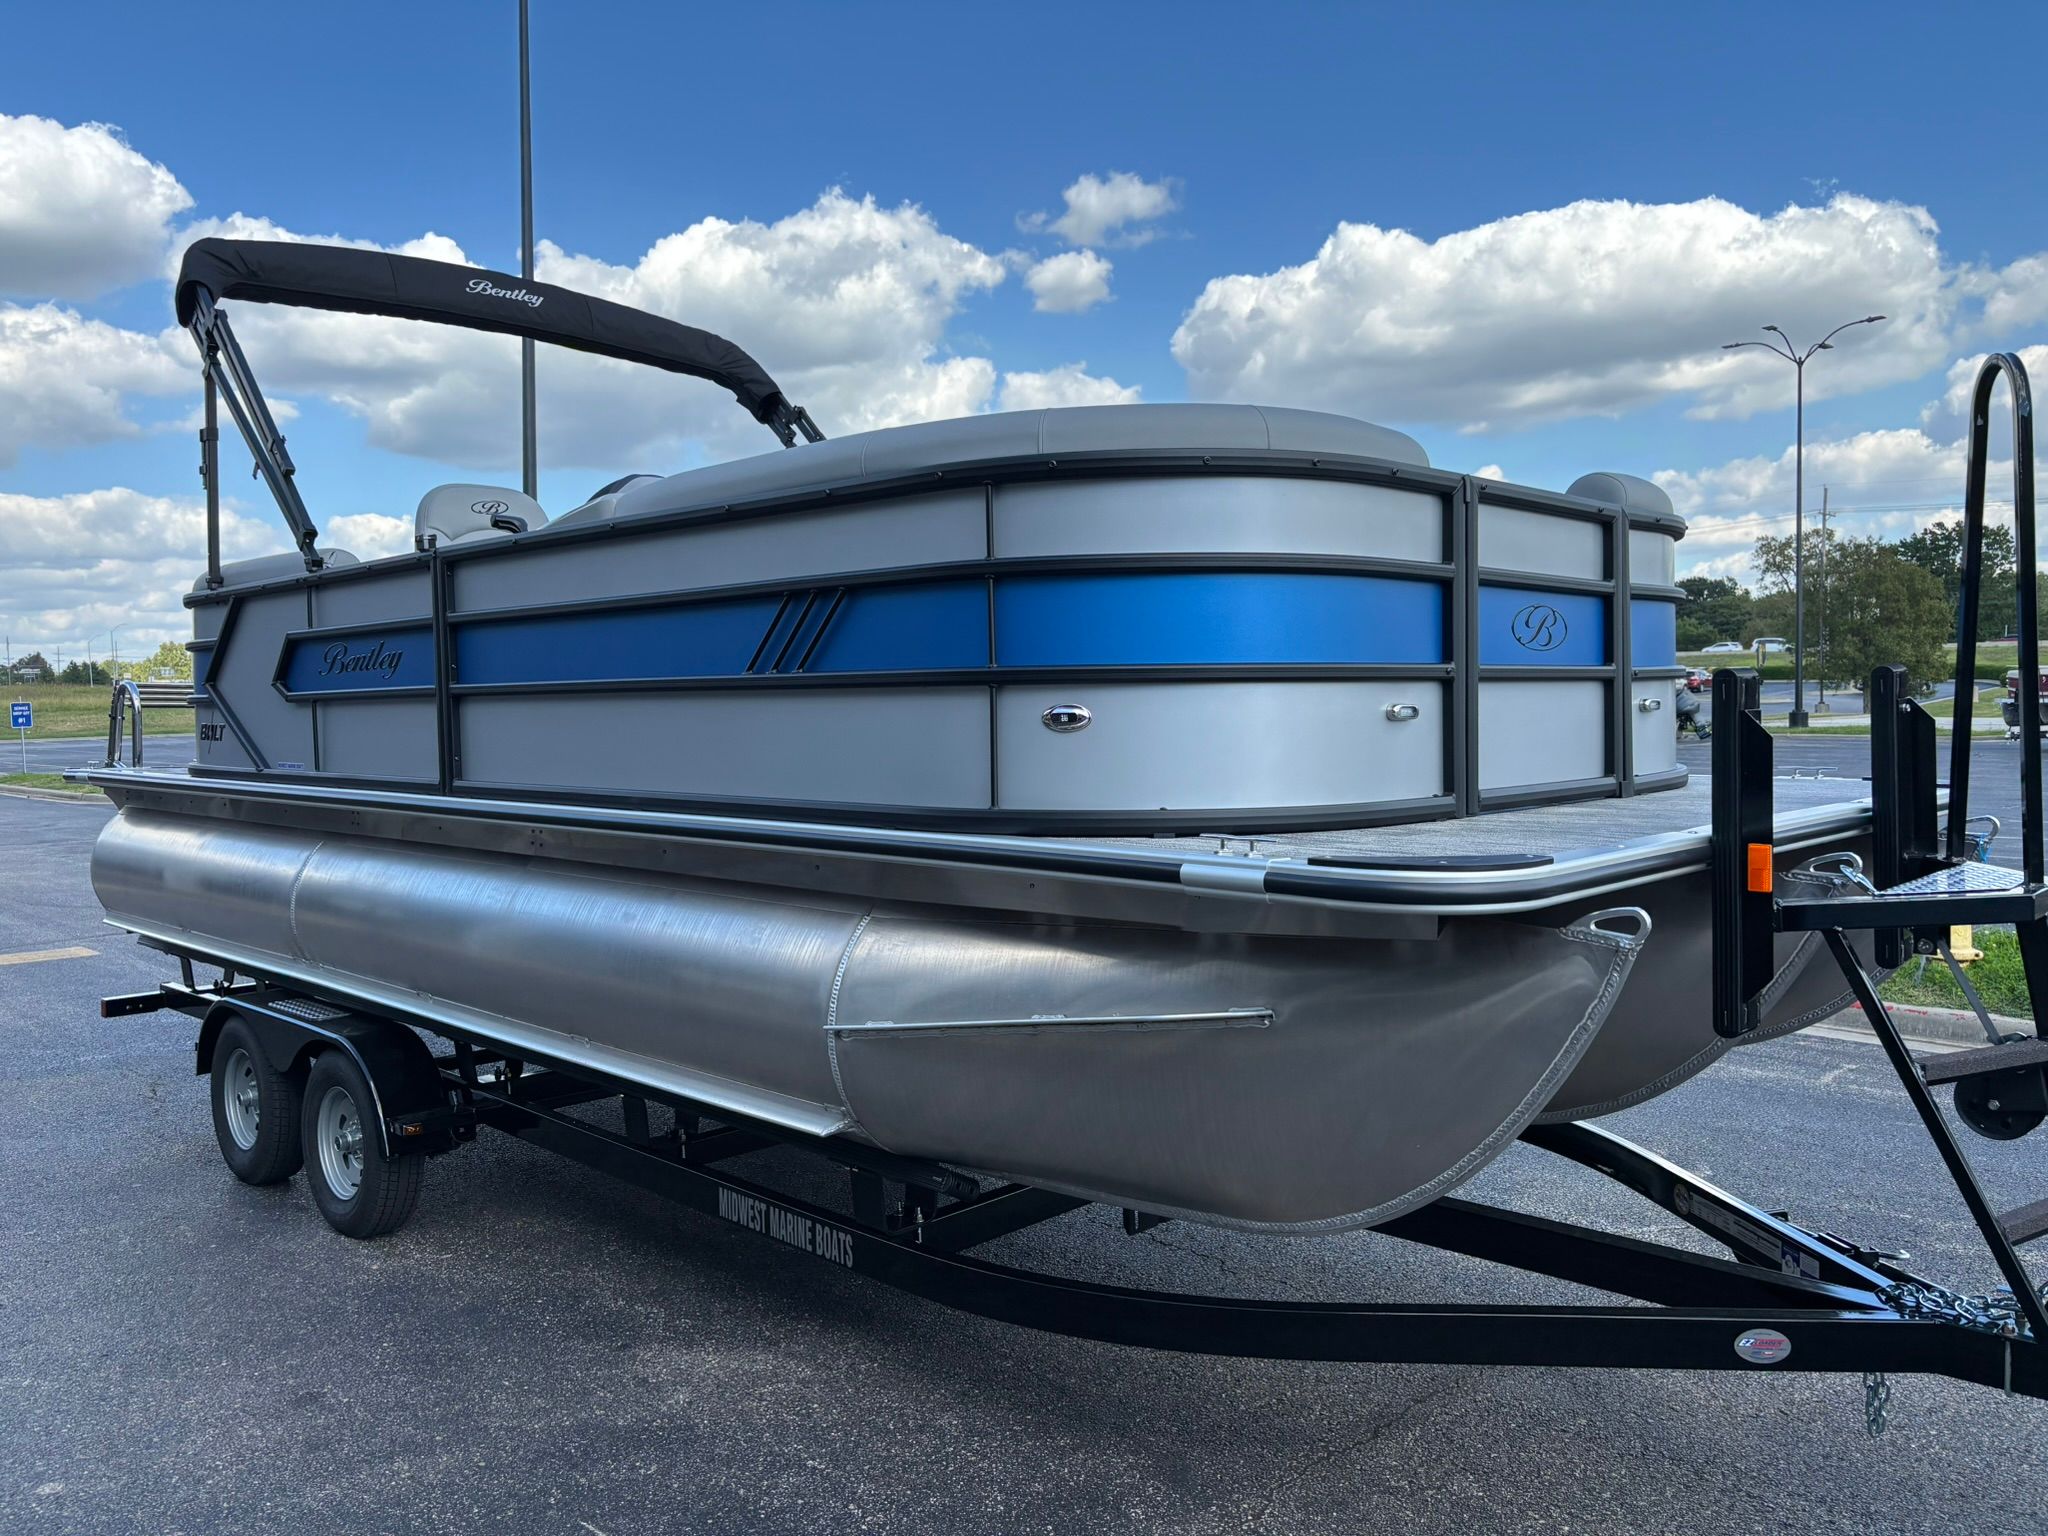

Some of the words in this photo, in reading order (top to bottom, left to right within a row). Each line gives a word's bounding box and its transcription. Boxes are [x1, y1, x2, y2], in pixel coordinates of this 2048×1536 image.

[465, 279, 544, 307] Bentley
[1516, 605, 1558, 647] B
[319, 640, 403, 679] Bentley
[718, 1186, 767, 1234] MIDWEST
[769, 1206, 813, 1252] MARINE
[815, 1223, 853, 1268] BOATS
